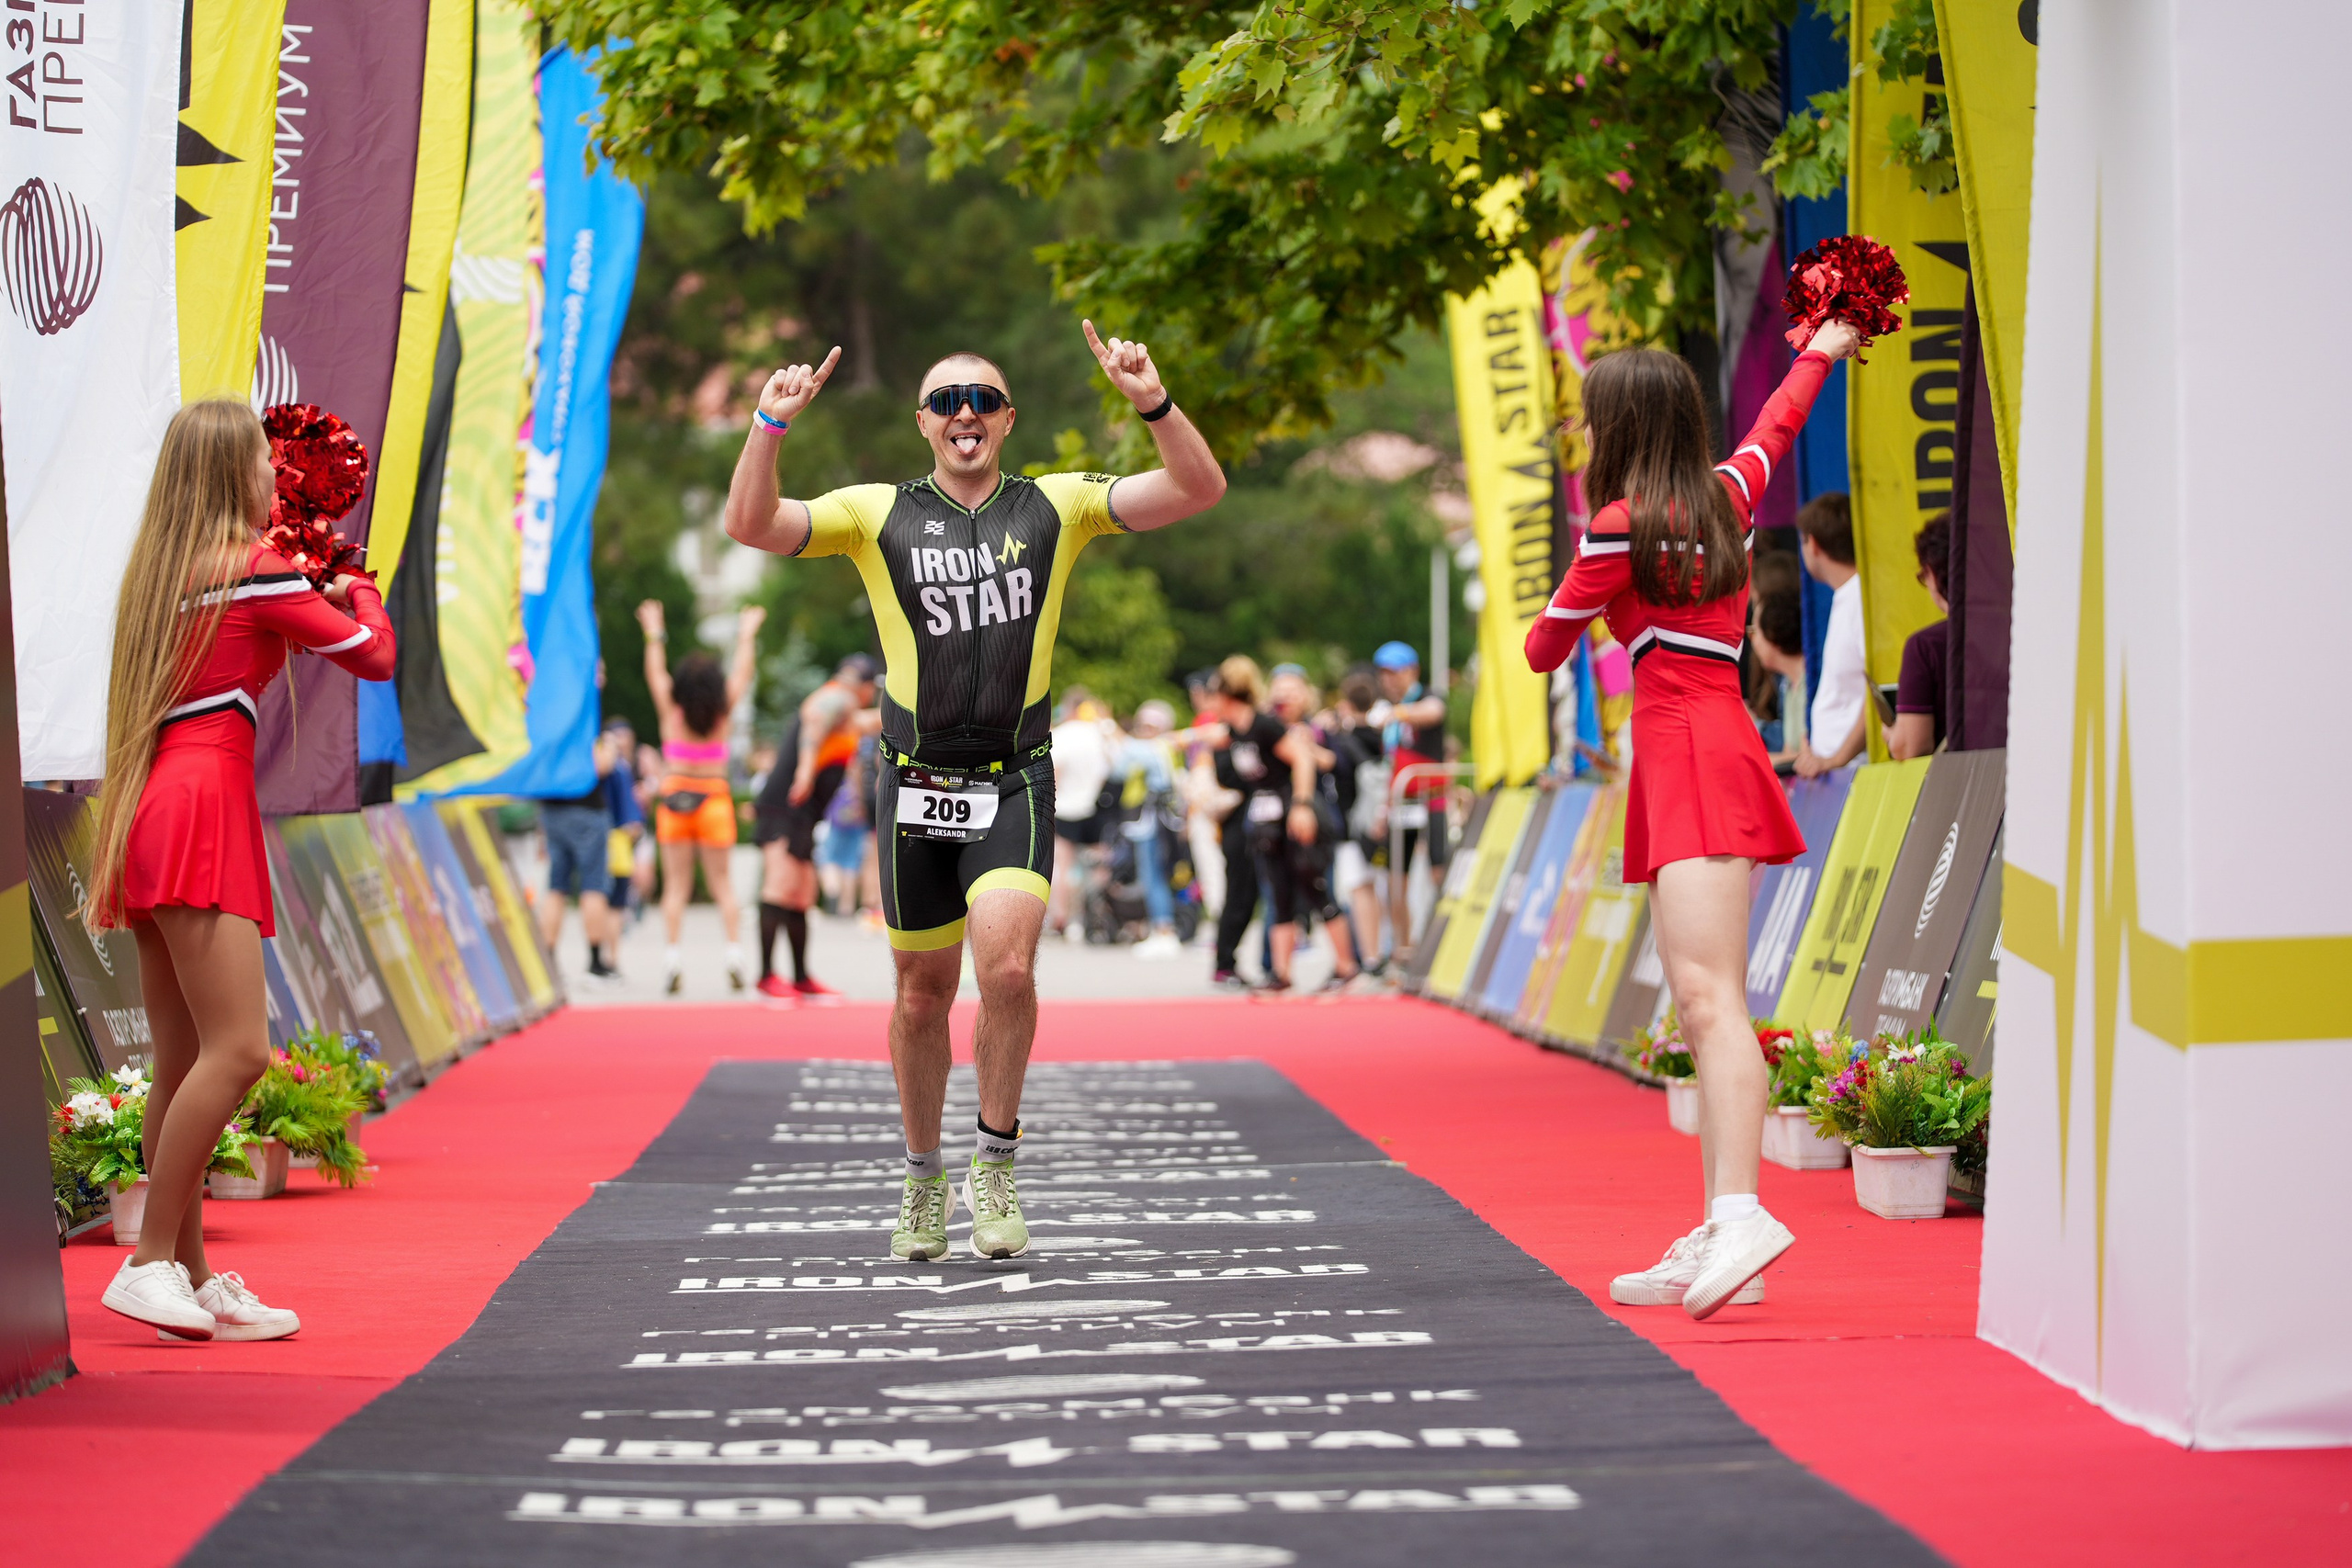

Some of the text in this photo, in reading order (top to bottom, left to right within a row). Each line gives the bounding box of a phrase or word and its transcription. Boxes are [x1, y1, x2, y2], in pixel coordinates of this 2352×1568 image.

[42, 0, 84, 134] ПРЕ
[264, 24, 313, 293] ПРЕМИУМ
[1486, 307, 1528, 434] STAR
[910, 541, 997, 583] IRON
[920, 567, 1033, 637] STAR
[931, 775, 944, 784] IRON
[922, 796, 971, 823] 209
[926, 828, 967, 838] ALEKSANDR
[1069, 1210, 1316, 1222] STAR
[677, 1264, 1369, 1289] IRON STAR
[630, 1331, 1432, 1363] IRON STAR
[561, 1427, 1521, 1458] IRON STAR
[517, 1484, 1580, 1519] IRON STAR
